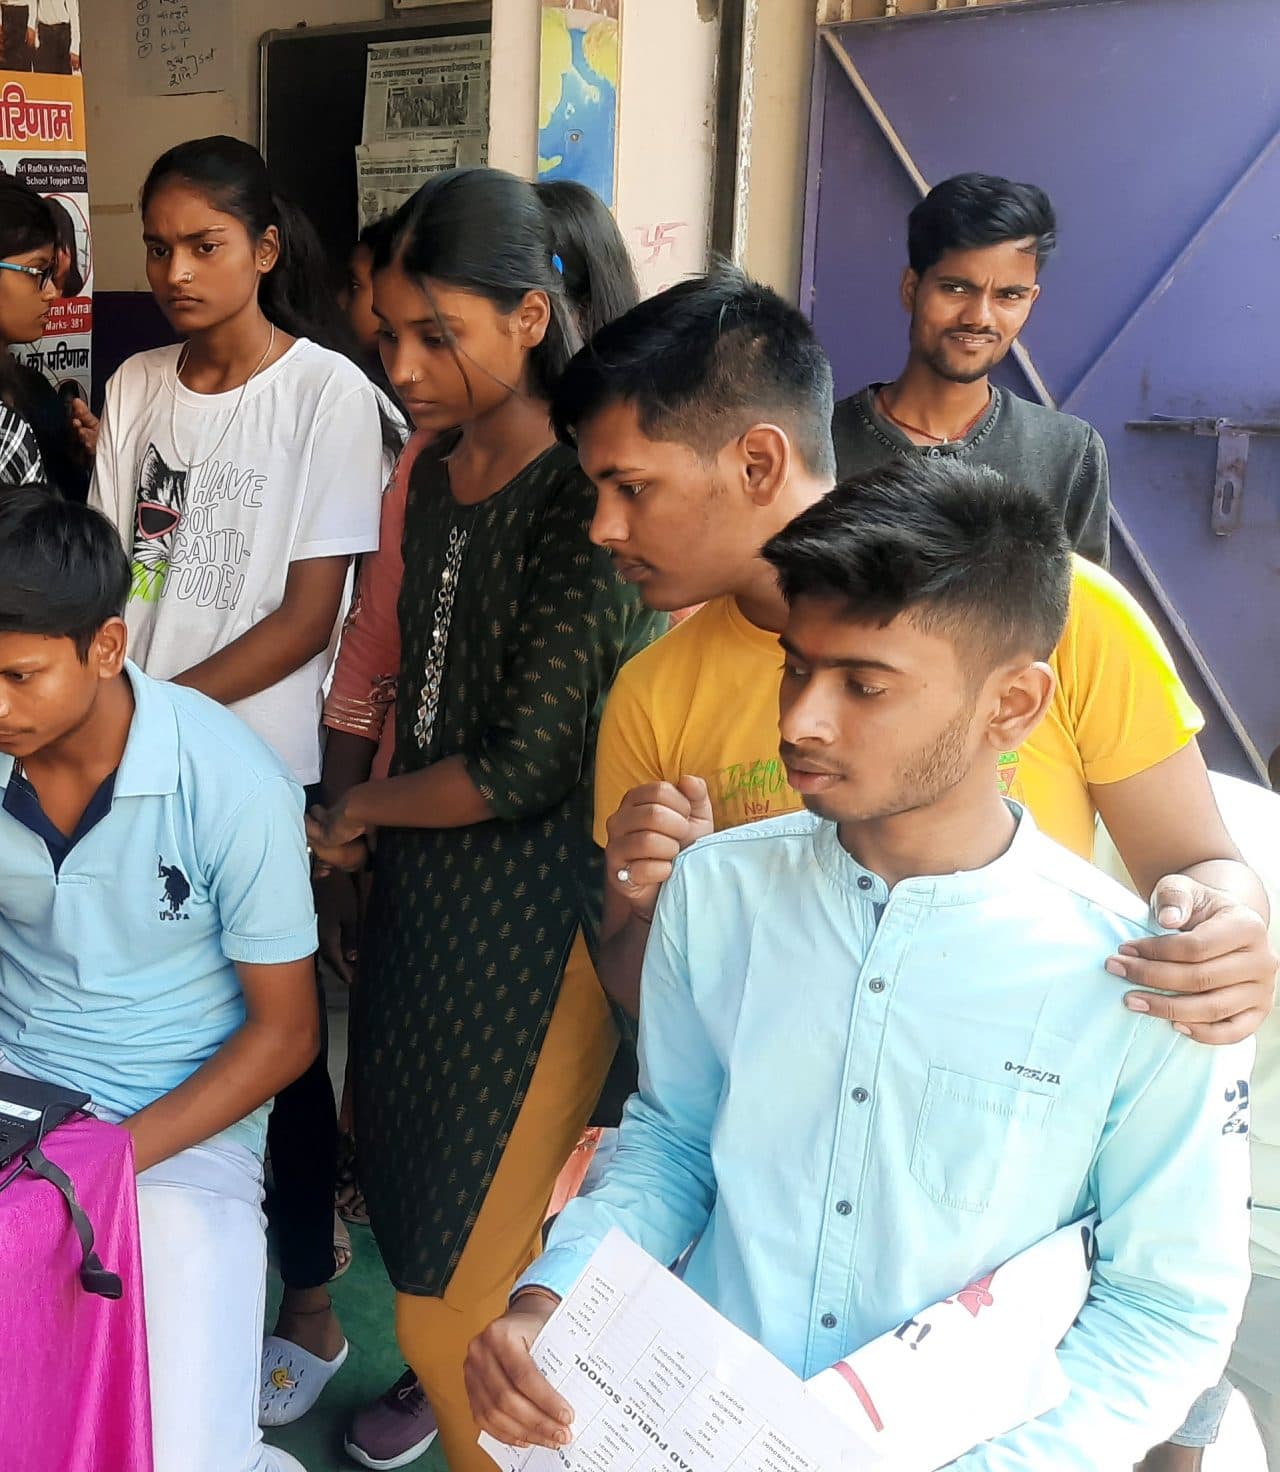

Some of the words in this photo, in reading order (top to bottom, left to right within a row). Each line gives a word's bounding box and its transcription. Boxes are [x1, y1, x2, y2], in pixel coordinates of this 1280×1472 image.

[26, 176, 48, 185] School
[26, 352, 44, 372] का
[47, 341, 89, 370] परिणाम
[193, 460, 267, 508] HAVE
[161, 564, 246, 610] TUDE!
[570, 1353, 622, 1404] SCHOOL
[621, 1403, 669, 1451] PUBLIC
